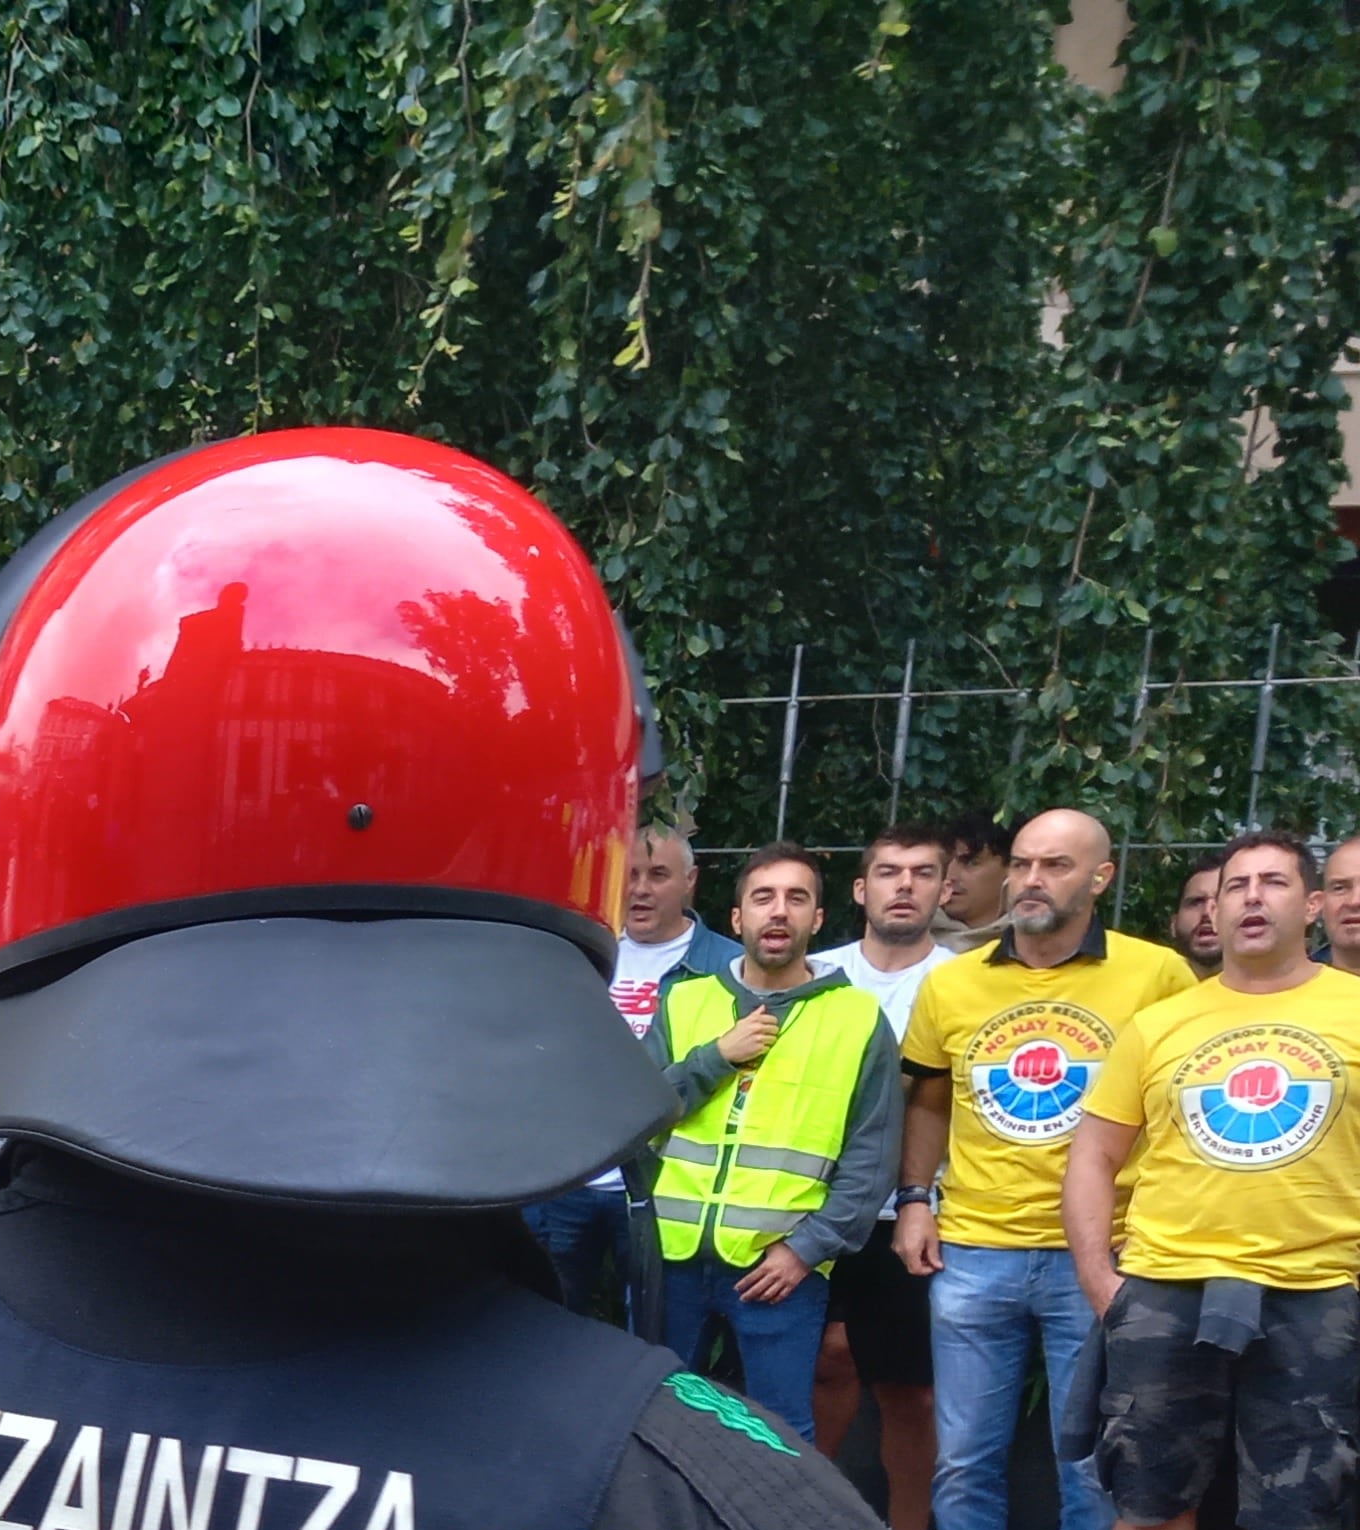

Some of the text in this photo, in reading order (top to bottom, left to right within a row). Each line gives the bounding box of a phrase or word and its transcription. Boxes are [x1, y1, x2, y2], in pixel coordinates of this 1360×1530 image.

[984, 1020, 1099, 1054] NO HAY TOUR
[1051, 1006, 1113, 1049] REGULADO
[1194, 1041, 1322, 1075] NO HAY TOUR
[1043, 1120, 1063, 1132] EN
[1261, 1144, 1283, 1156] EN
[1287, 1104, 1325, 1146] LUCHA
